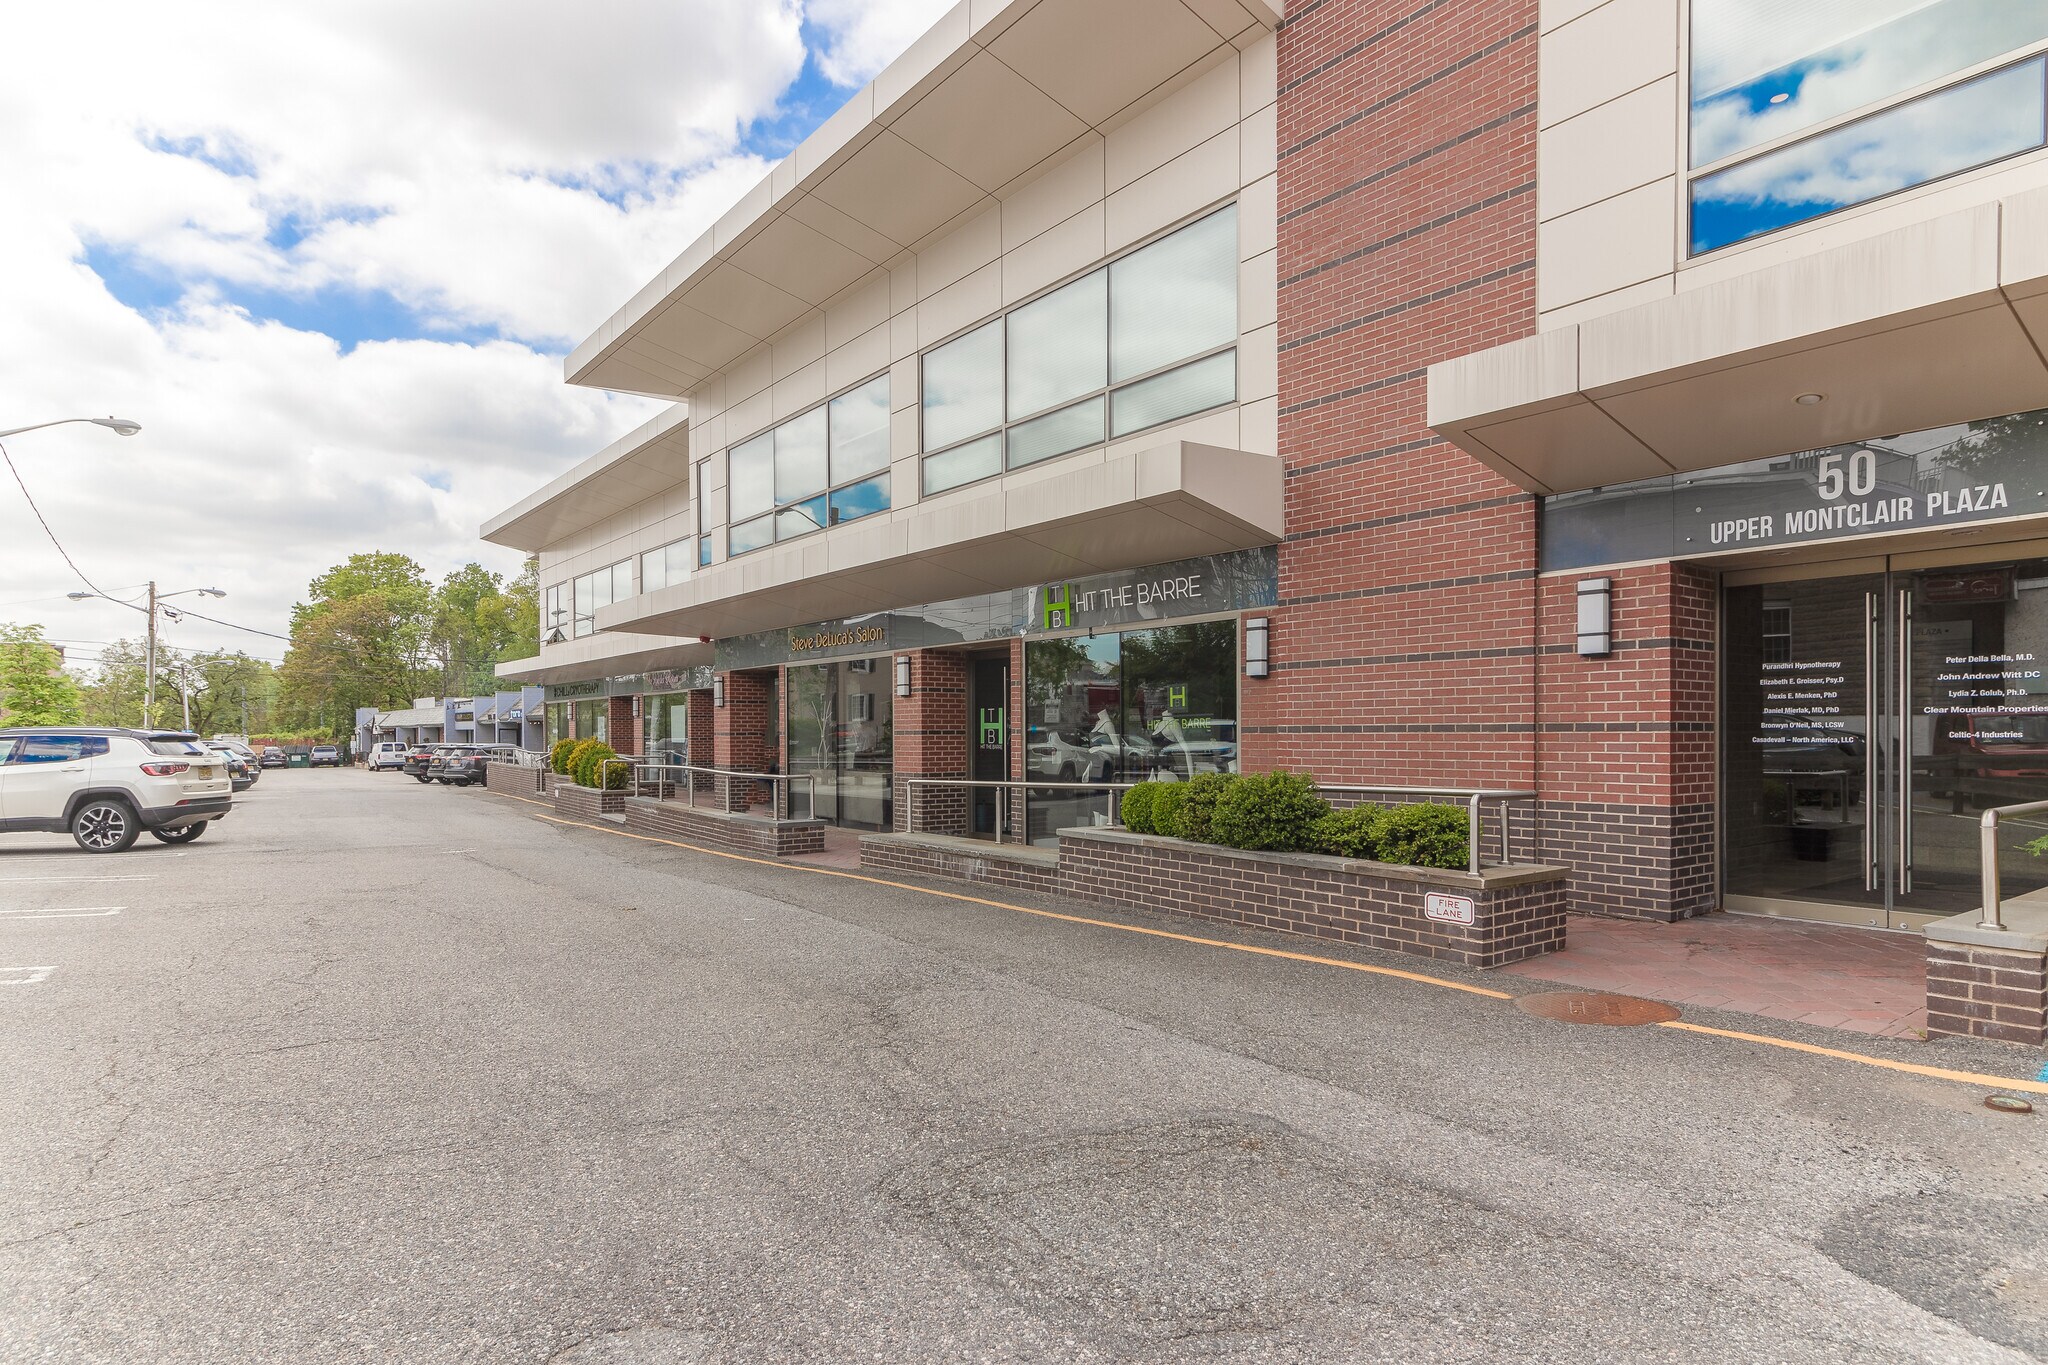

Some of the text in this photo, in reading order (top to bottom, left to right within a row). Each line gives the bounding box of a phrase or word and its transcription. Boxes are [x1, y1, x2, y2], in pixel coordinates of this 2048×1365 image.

[1818, 449, 1876, 500] 50
[1710, 483, 2008, 545] UPPER MONTCLAIR PLAZA
[1075, 575, 1202, 613] HIT THE BARRE
[791, 625, 883, 652] Steve DeLuca's Salon
[1945, 656, 1967, 664] Peter
[1990, 654, 2014, 662] Bella,
[2015, 653, 2035, 661] M.D.
[1794, 661, 1841, 670] Hypnotherapy
[1937, 670, 2041, 681] John Andrew Witt DC
[1759, 678, 1788, 686] Elizabeth
[1796, 677, 1825, 685] Groisser,
[1825, 676, 1844, 684] Psy.D
[1948, 690, 1969, 698] Lydia
[1979, 689, 2005, 697] Golub,
[2006, 688, 2028, 696] Ph.D.
[1923, 704, 2048, 714] Clear Mountain Properties
[1181, 717, 1212, 729] BARRE
[1948, 730, 2024, 739] Celtic-4 Industries
[1810, 736, 1840, 744] America,
[1438, 899, 1460, 909] FIRE
[1436, 908, 1462, 918] LANE
